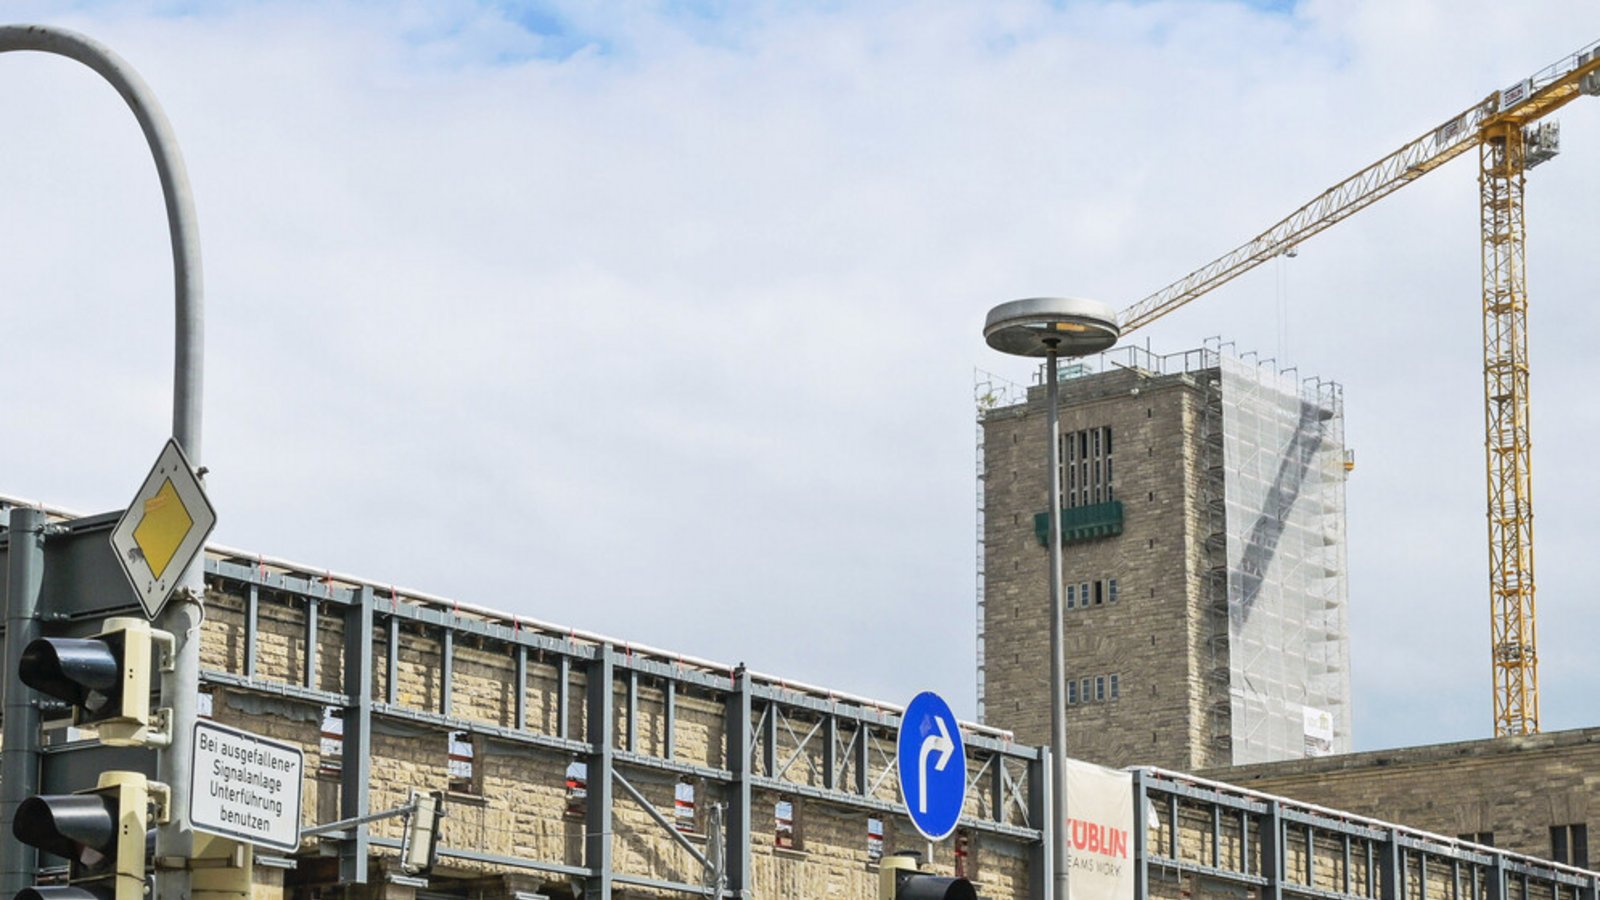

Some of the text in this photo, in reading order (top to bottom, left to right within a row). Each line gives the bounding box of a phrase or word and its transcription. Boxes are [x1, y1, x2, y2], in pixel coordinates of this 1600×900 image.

[200, 733, 296, 772] Bei ausgefallener
[213, 759, 282, 794] Signalanlage
[210, 780, 283, 817] Unterführung
[220, 805, 270, 831] benutzen
[1067, 818, 1127, 859] ÜBLIN
